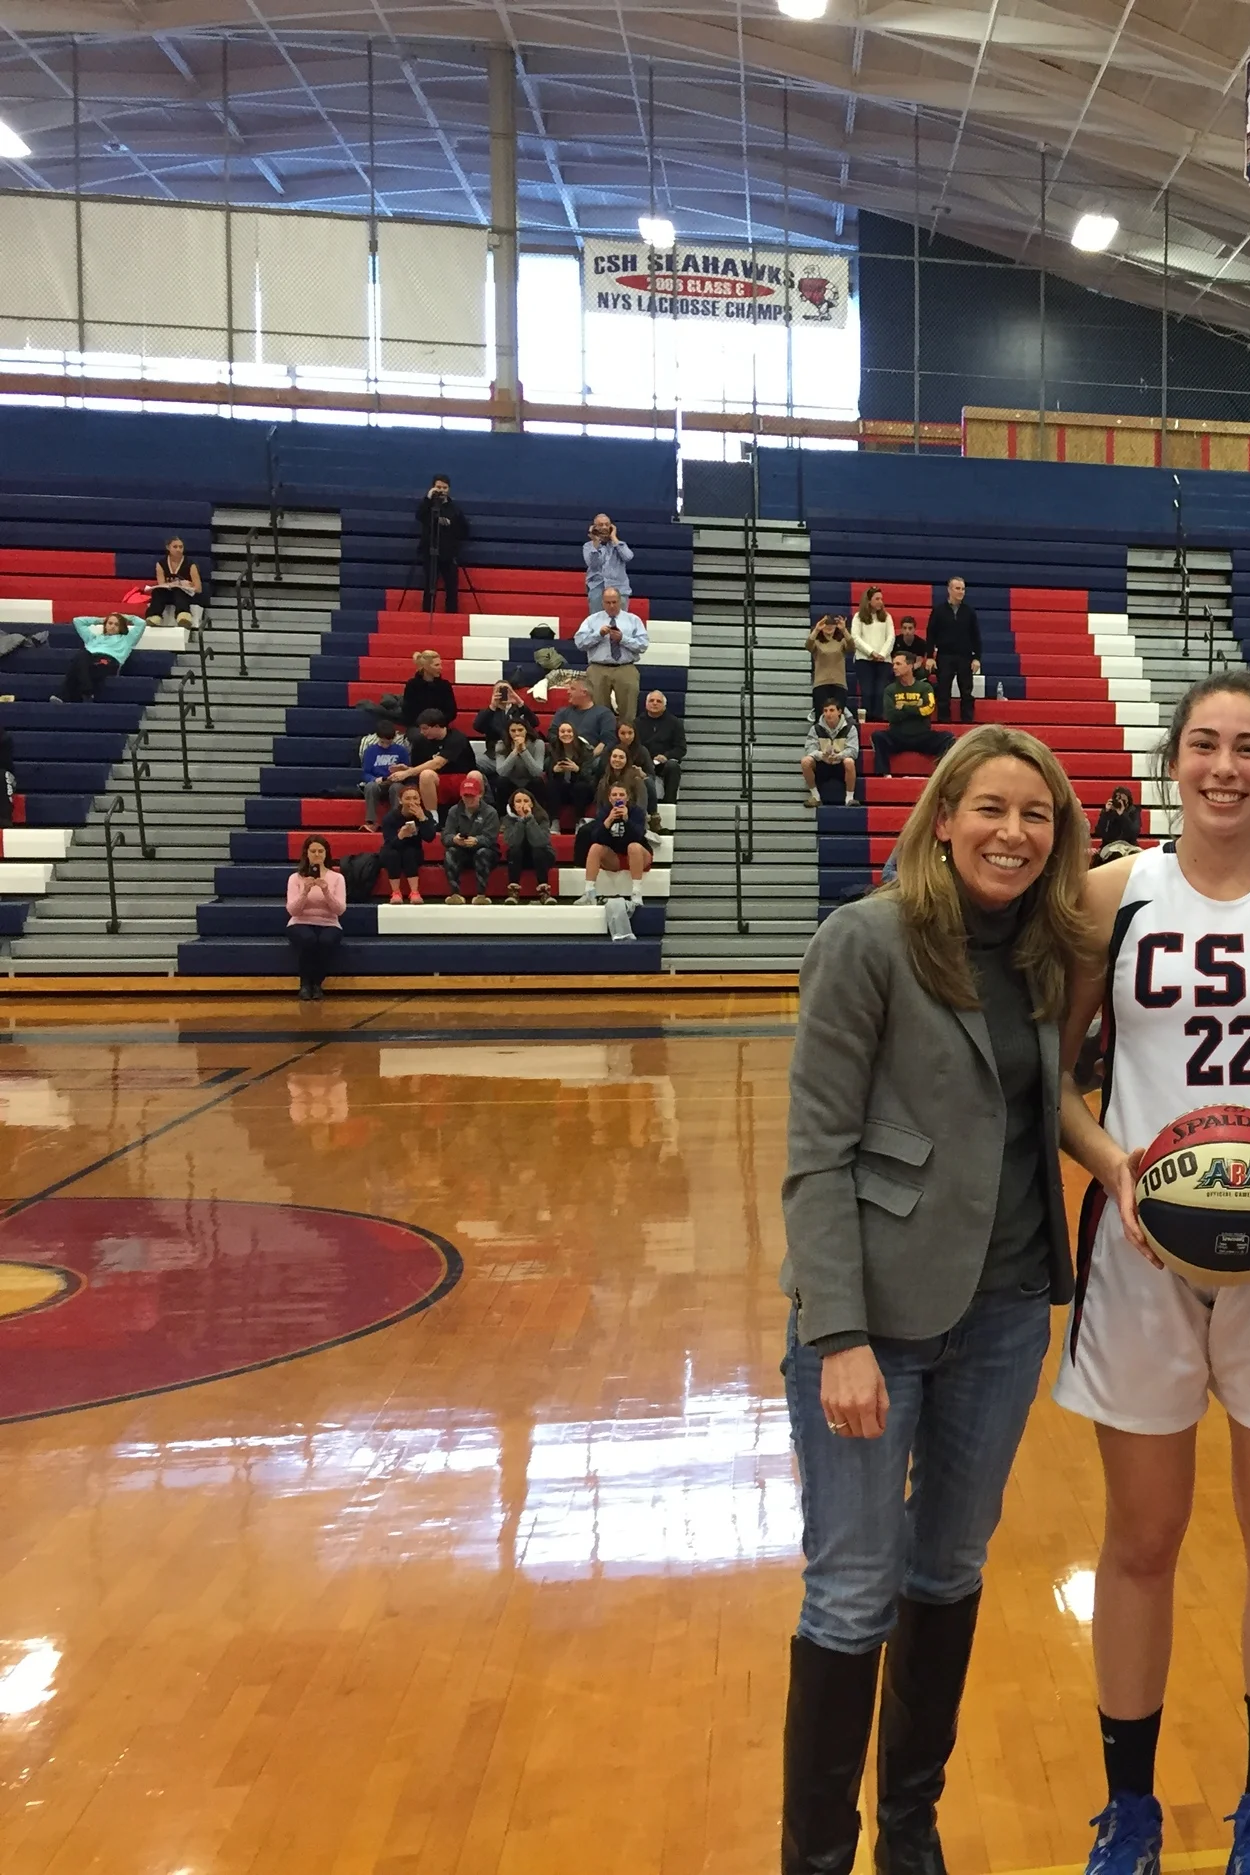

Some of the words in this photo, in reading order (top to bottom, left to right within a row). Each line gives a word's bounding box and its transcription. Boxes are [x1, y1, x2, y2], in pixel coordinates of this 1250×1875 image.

[594, 254, 638, 276] CSH
[647, 253, 795, 290] SEAHAWKS
[687, 279, 732, 295] CLASS
[597, 292, 632, 311] NYS
[638, 296, 720, 317] LACROSSE
[725, 300, 793, 322] CHAMPS
[1142, 1151, 1198, 1197] 1000
